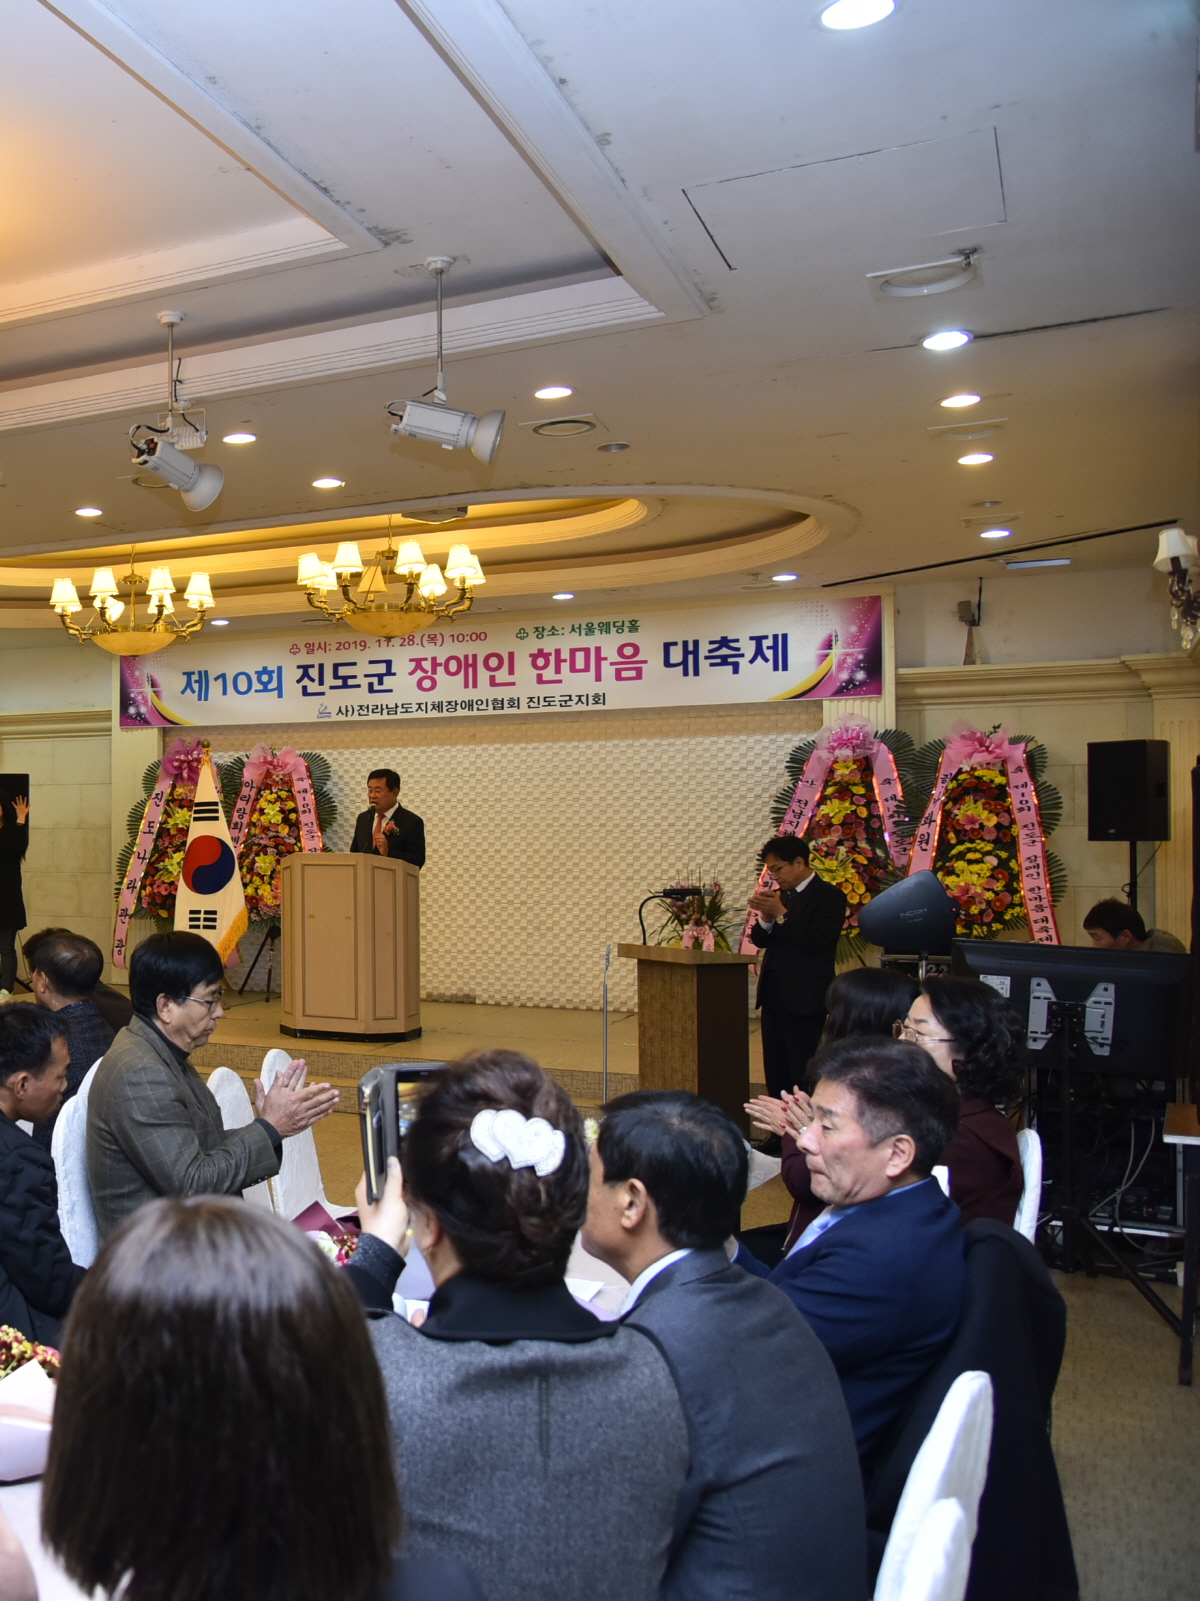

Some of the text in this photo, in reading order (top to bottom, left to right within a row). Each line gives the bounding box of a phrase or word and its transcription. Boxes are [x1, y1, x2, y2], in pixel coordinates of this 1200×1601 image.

[532, 618, 641, 640] 장소: 서울웨딩홀
[304, 641, 332, 655] 일시:
[335, 639, 371, 652] 2019.
[399, 632, 445, 649] 28.(목)
[448, 631, 488, 644] 10:00
[179, 632, 789, 702] 제10회 진도군 장애인 한마음 대축제
[526, 692, 607, 710] 진도군지회
[1021, 822, 1042, 847] 진도군
[1024, 854, 1041, 880] 장애인
[1027, 885, 1048, 913] 한마음
[1032, 915, 1053, 942] 대축제
